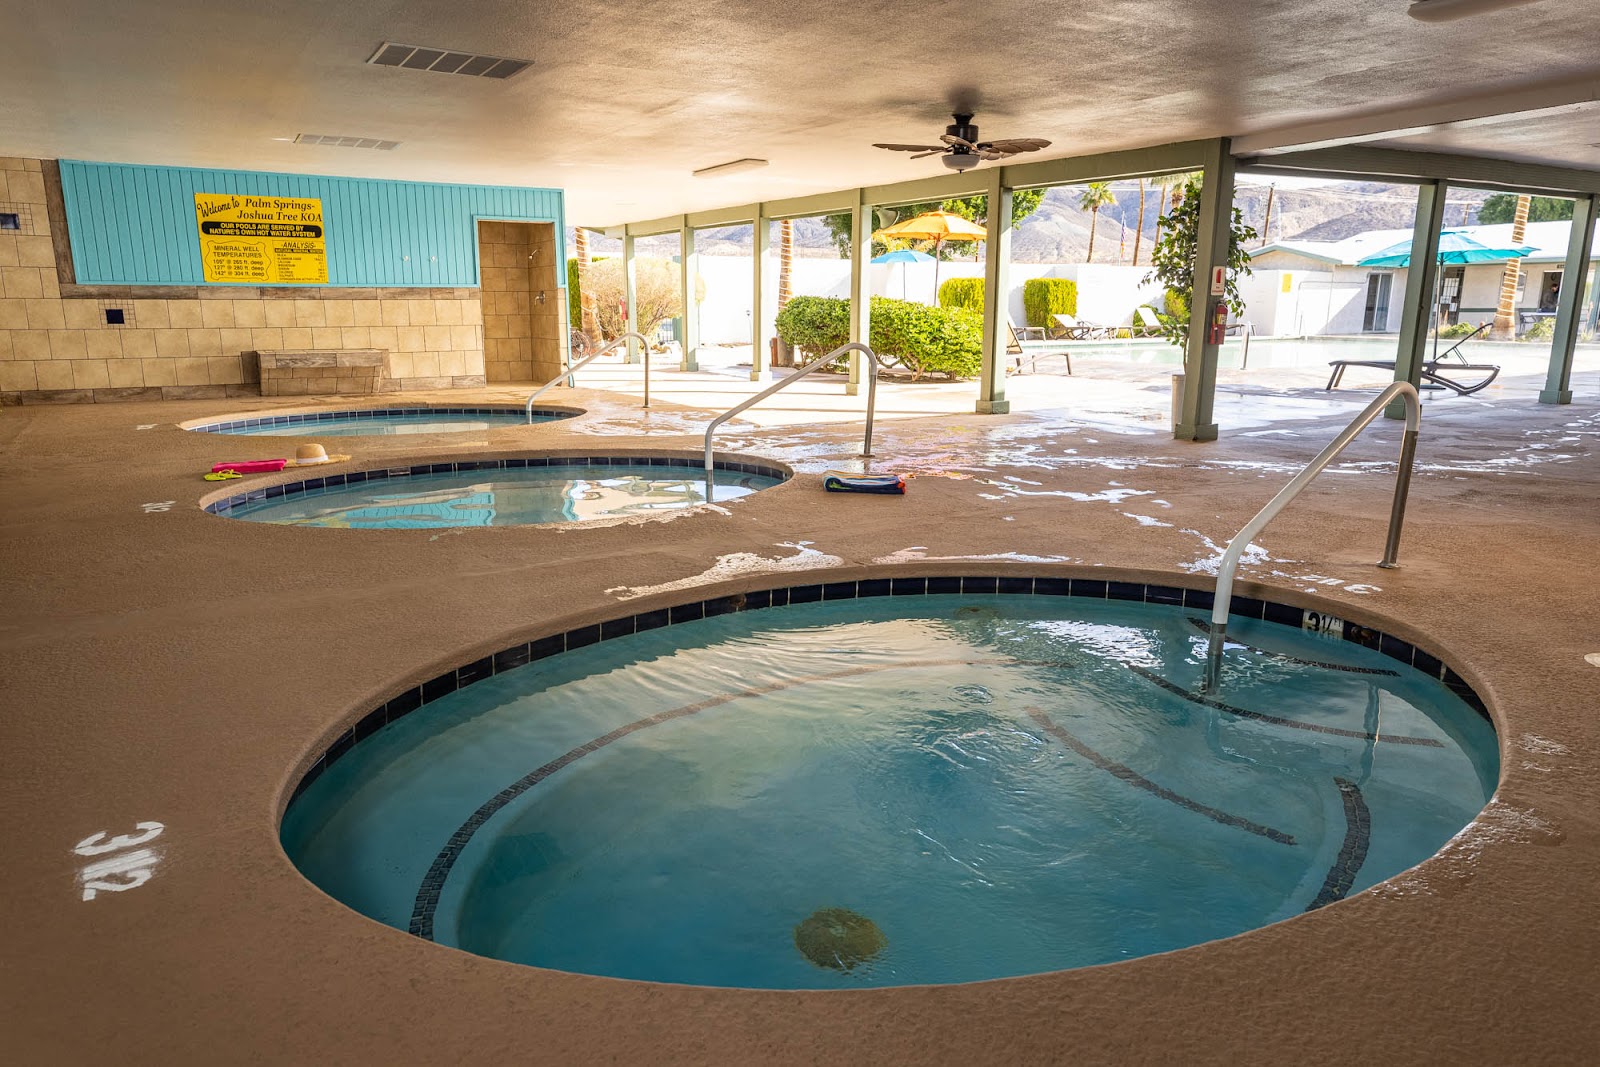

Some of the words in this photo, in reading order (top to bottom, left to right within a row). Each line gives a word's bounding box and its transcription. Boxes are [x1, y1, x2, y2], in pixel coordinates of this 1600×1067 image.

[196, 200, 231, 218] Welcome
[232, 196, 240, 209] to
[245, 198, 271, 208] Palm
[273, 199, 315, 212] Springs-
[237, 210, 273, 220] Joshua
[276, 211, 298, 221] Tree
[300, 212, 322, 222] KOA
